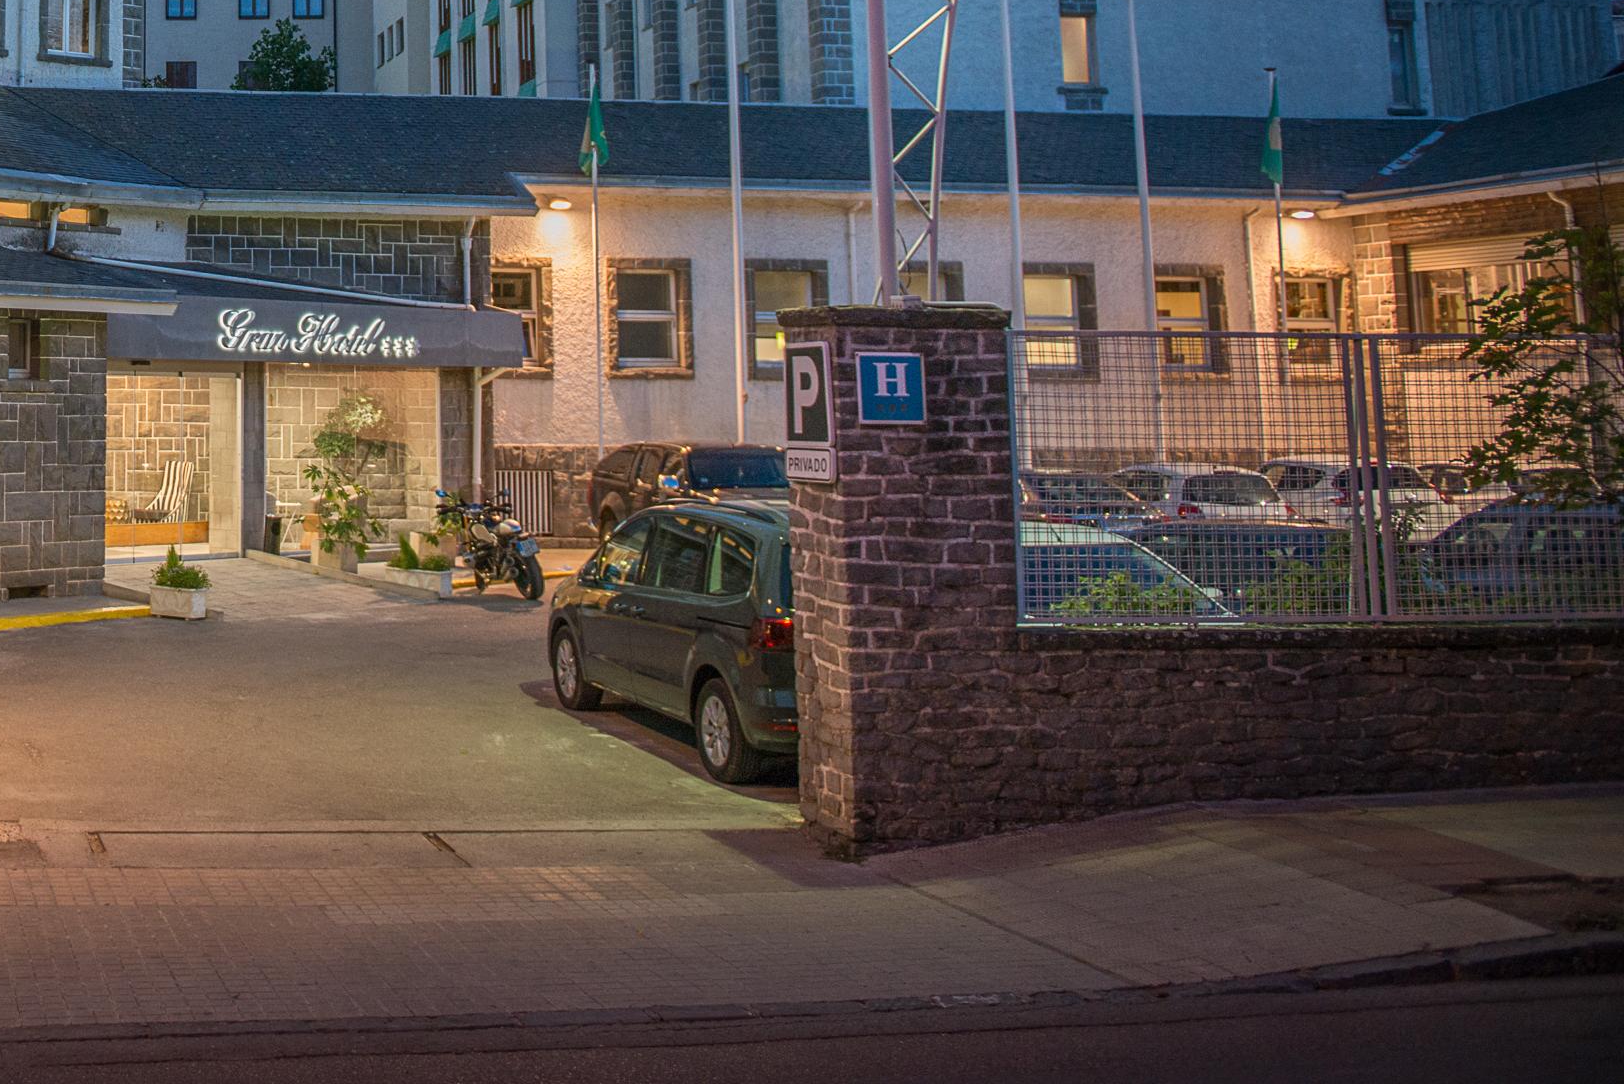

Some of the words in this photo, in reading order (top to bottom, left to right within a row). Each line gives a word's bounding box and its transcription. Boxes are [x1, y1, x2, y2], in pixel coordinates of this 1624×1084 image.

[217, 308, 289, 353] Gran
[291, 312, 386, 356] Hotel
[792, 356, 819, 433] P
[873, 362, 910, 397] H
[788, 457, 827, 473] PRIVADO
